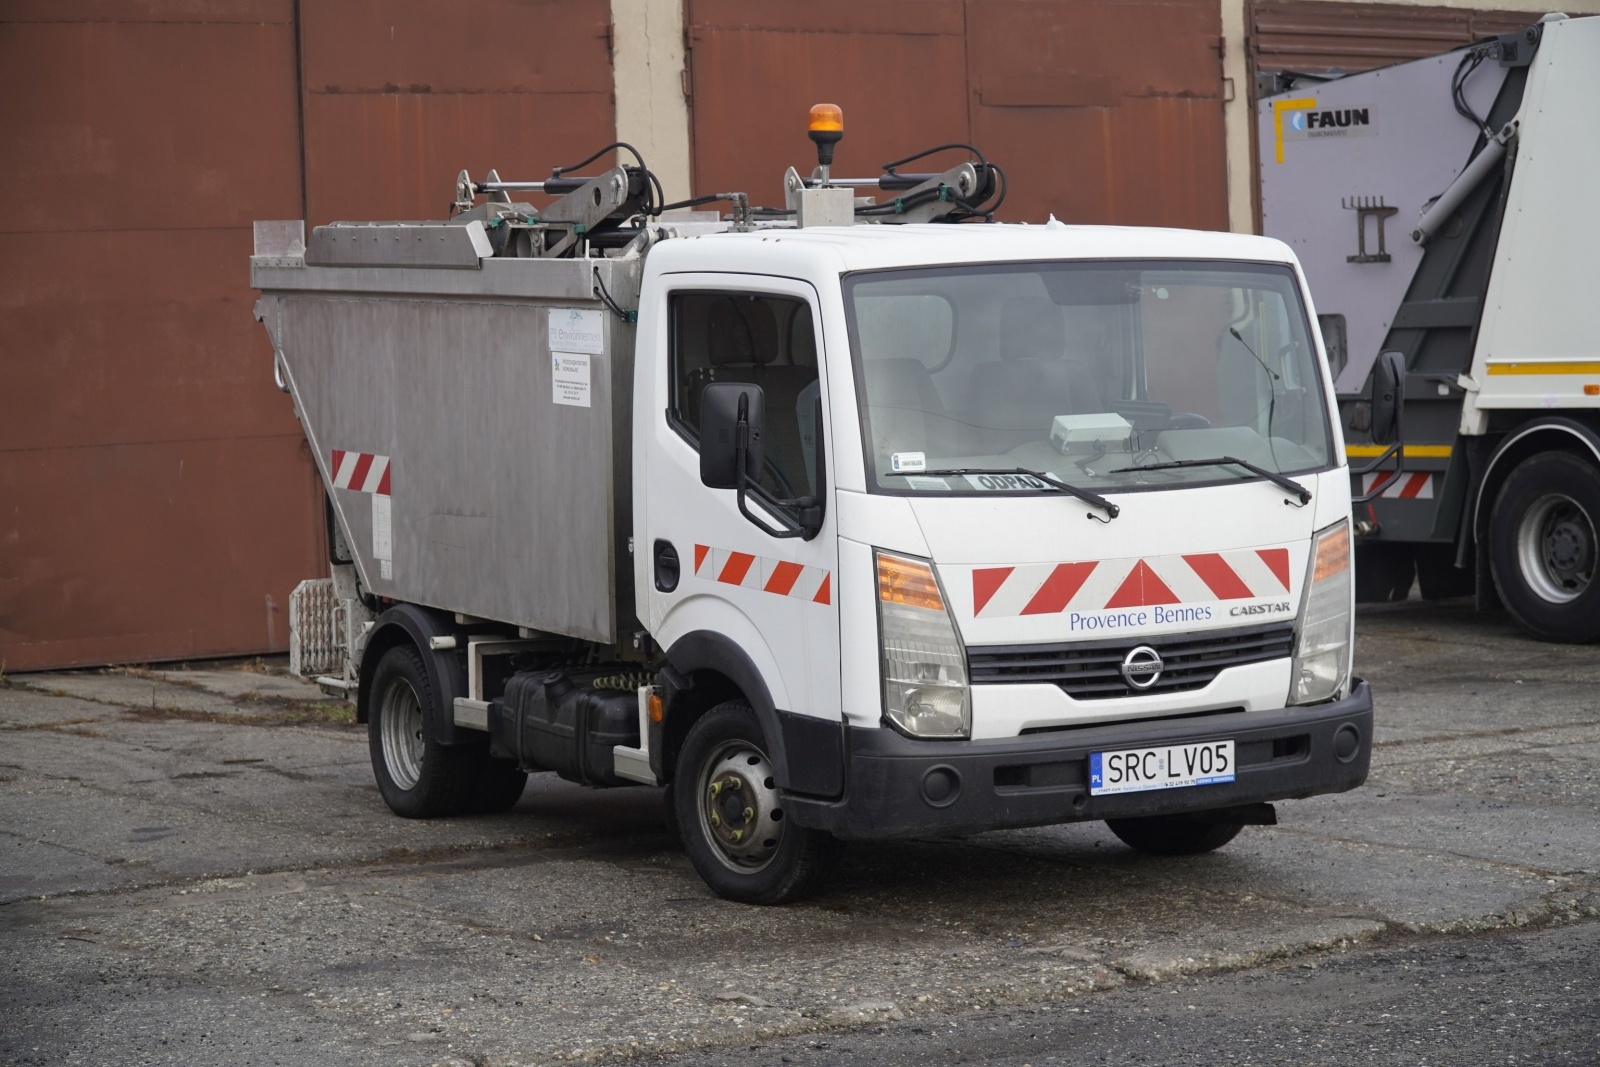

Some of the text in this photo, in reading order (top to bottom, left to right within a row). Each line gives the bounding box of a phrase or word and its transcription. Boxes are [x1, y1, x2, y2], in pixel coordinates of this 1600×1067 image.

[1307, 108, 1369, 129] FAUN
[1070, 605, 1212, 631] Provence Bennes
[1230, 602, 1291, 617] CABSTAR
[1127, 664, 1160, 672] NISSAN
[1108, 744, 1228, 783] SRC LV05
[1091, 774, 1102, 783] PL
